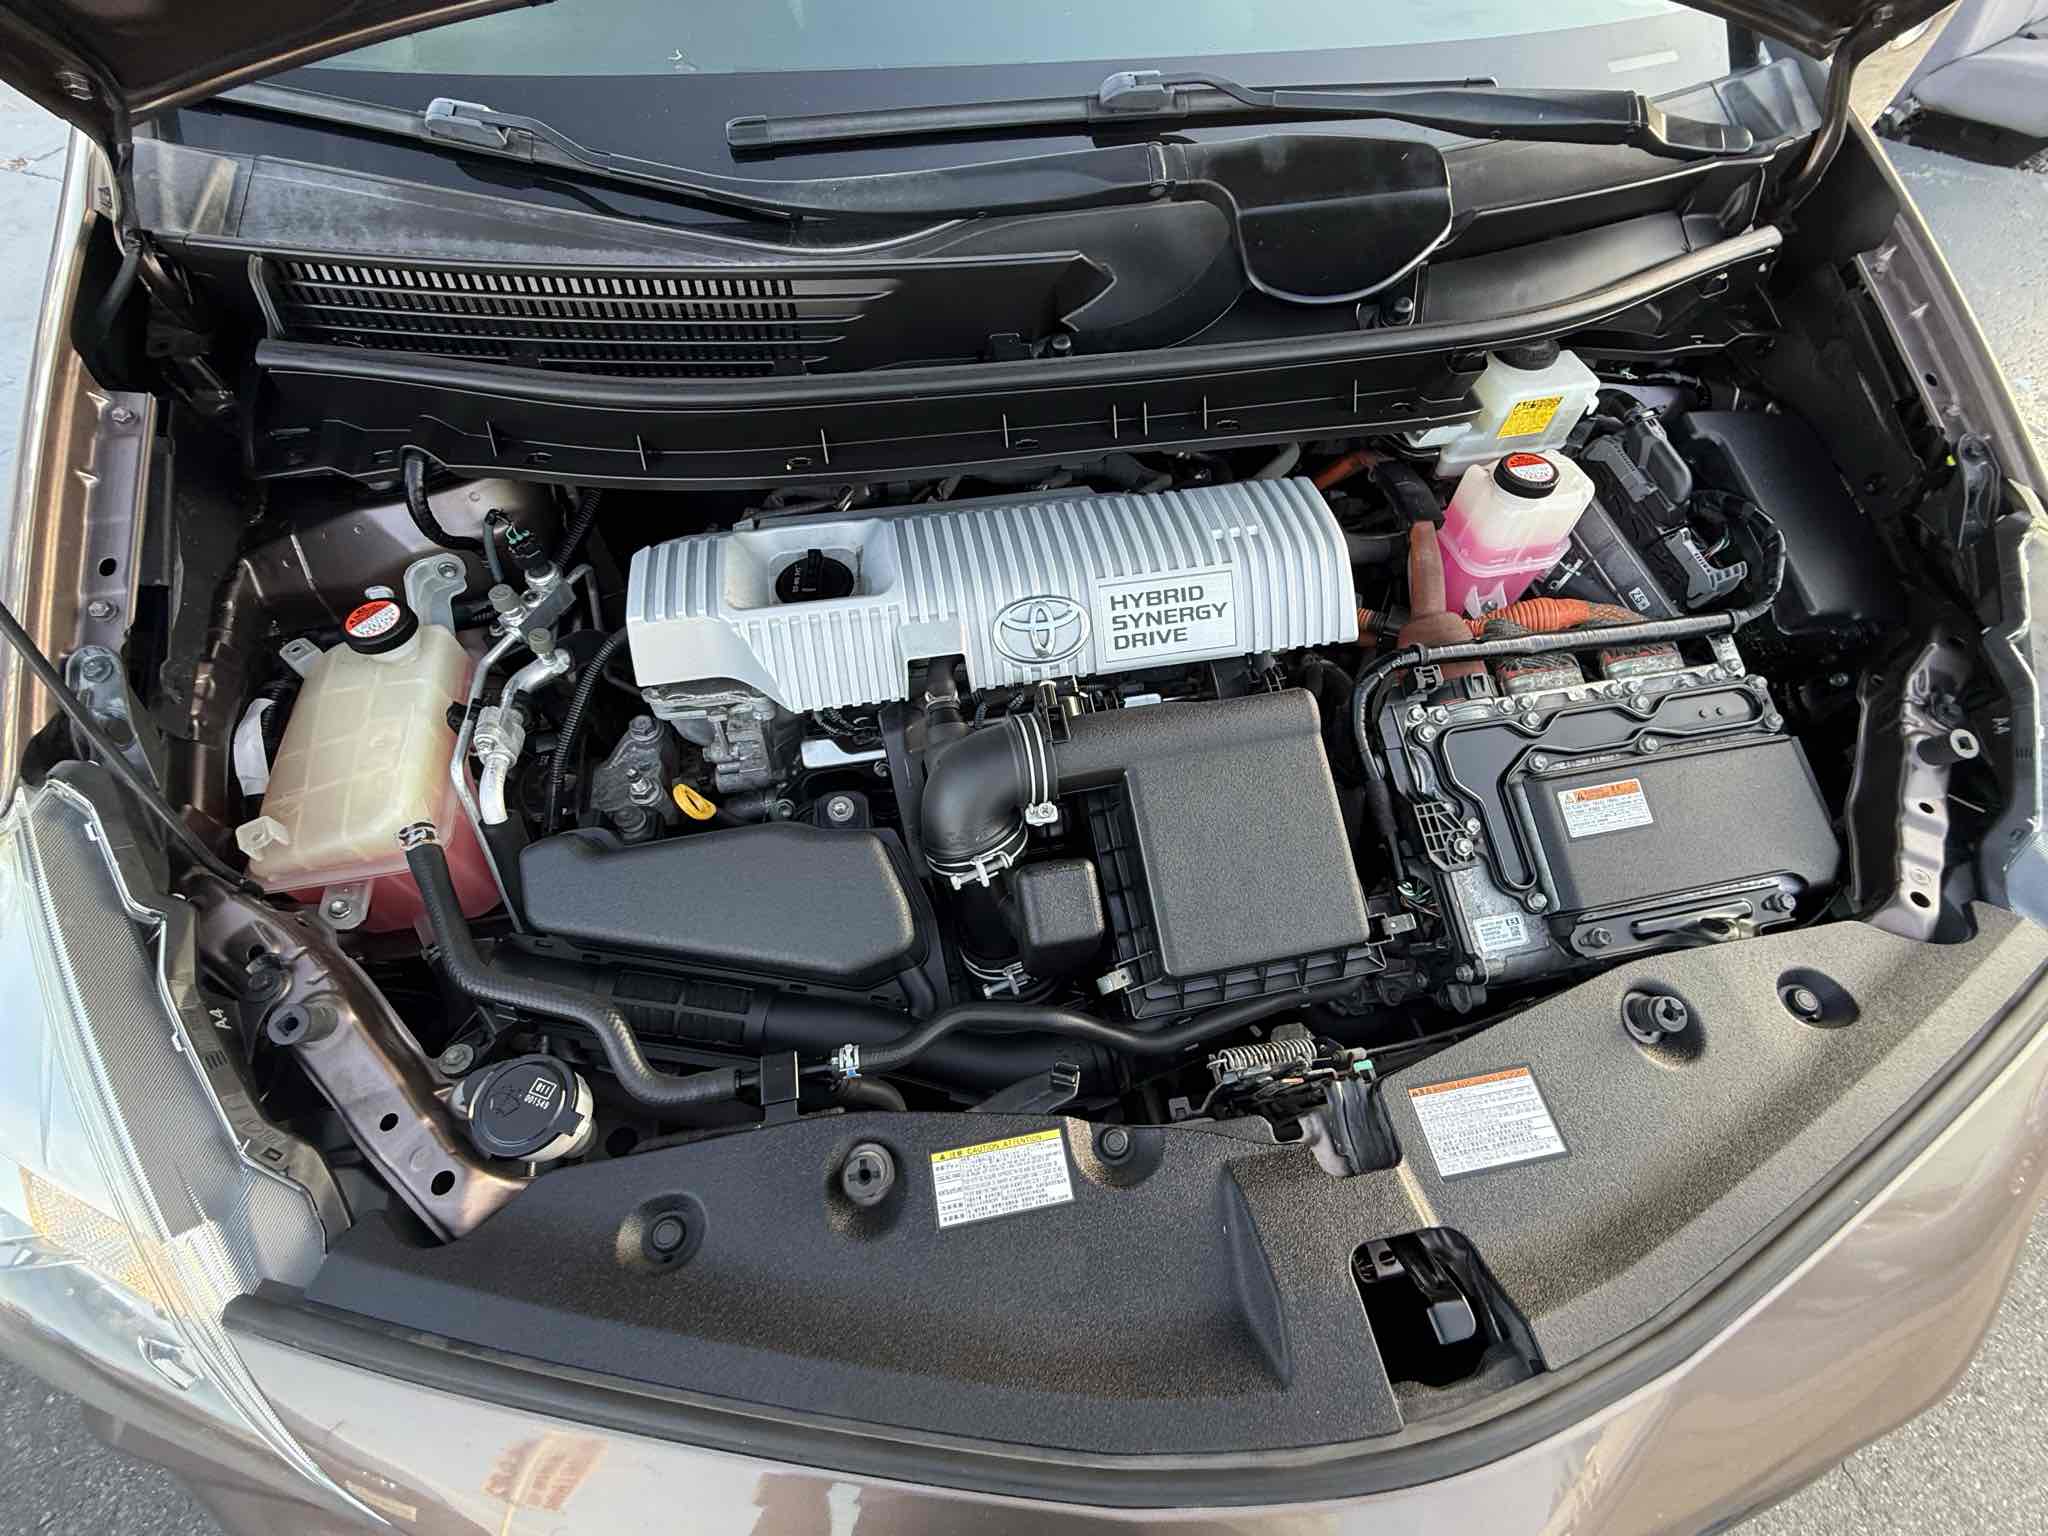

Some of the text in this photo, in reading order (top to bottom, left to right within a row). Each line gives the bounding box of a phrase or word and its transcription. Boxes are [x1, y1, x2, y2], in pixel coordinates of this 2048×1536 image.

[1110, 585, 1204, 611] HYBRID
[1112, 601, 1228, 631] SYNERGY
[1114, 627, 1188, 650] DRIVE
